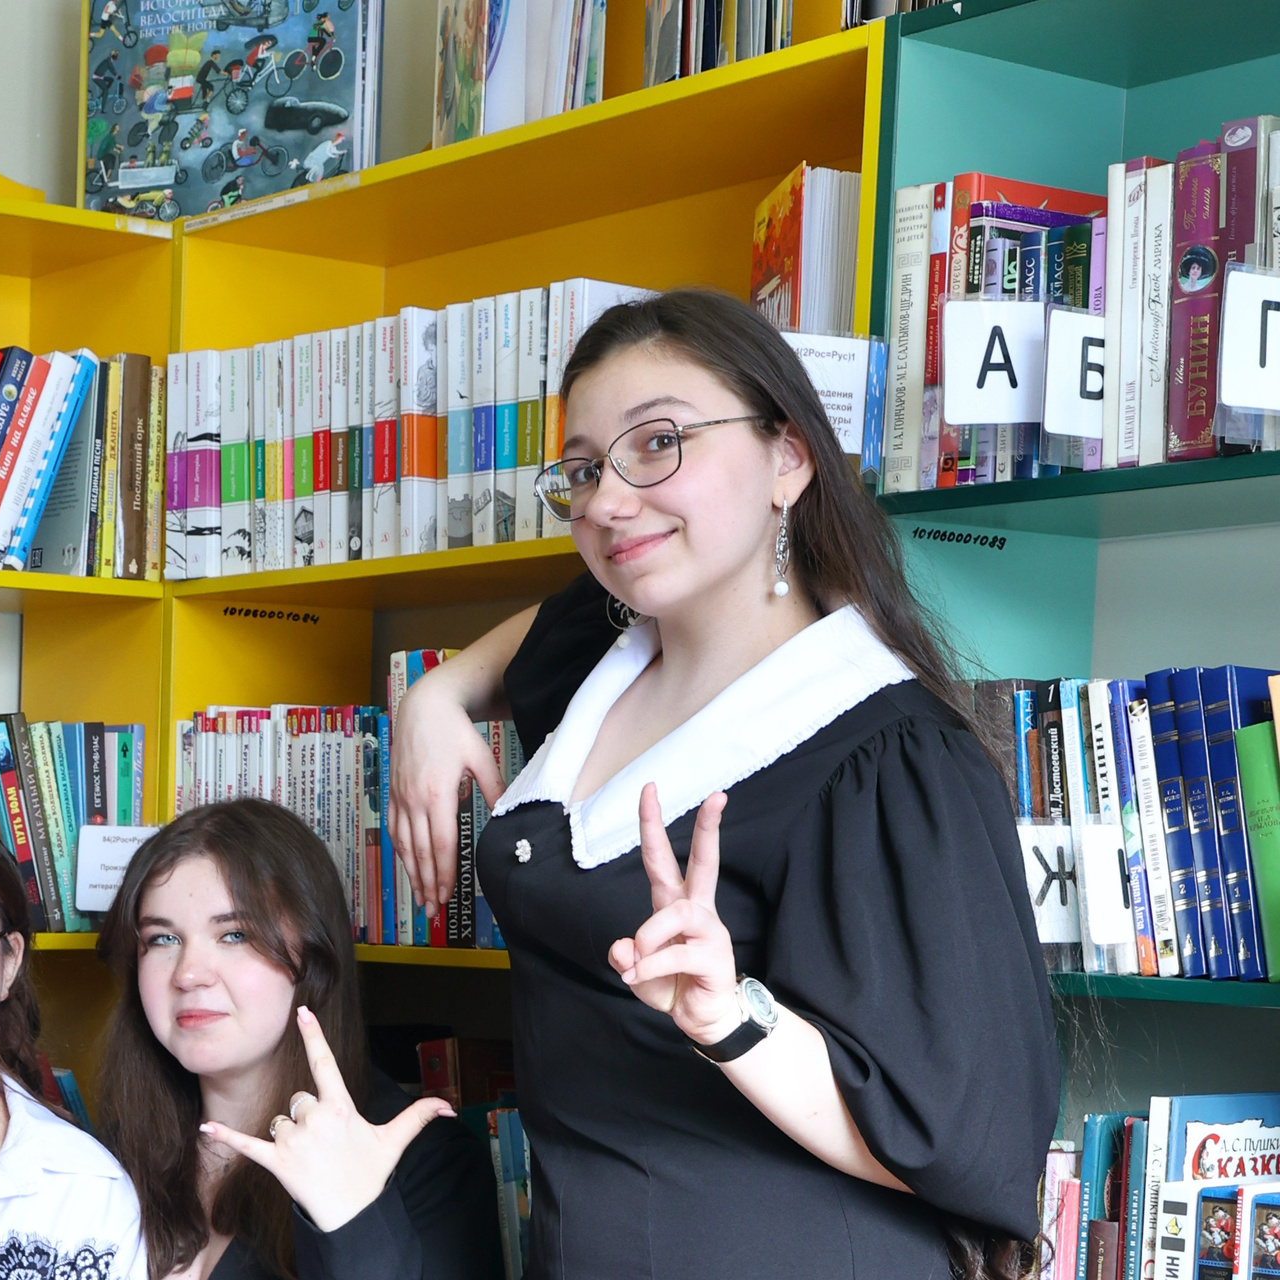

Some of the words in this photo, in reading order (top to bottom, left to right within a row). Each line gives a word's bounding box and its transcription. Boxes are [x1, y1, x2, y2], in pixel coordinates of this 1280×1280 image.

[139, 5, 227, 27] ВЕЛОСИПЕДА
[139, 26, 184, 39] БЫСТРЫЕ
[187, 20, 217, 34] НОГИ
[1152, 223, 1163, 269] ЛИРИКА
[897, 273, 914, 360] САЛТЫКОВ-ЩЕДРИН
[790, 347, 856, 362] 4(2Рос=Рус)1
[976, 325, 1019, 390] А
[1079, 336, 1105, 400] Б
[1174, 356, 1185, 385] Иван
[1187, 313, 1211, 418] БУНИН
[14, 386, 38, 428] пляже
[1123, 380, 1136, 401] БЛОК
[893, 386, 907, 431] ГОНЧАРОВ
[10, 431, 24, 449] на
[109, 409, 118, 460] ДЖАНЕТТА
[135, 417, 145, 440] орк
[1122, 404, 1136, 450] АЛЕКСАНДР
[93, 438, 102, 466] ПЕСНЯ
[91, 467, 101, 513] ЛЕБЕДИНАЯ
[133, 442, 144, 512] Последний
[911, 526, 1007, 551] 101060001089
[223, 606, 319, 625] 101060001084
[20, 739, 31, 769] ЛУК
[92, 734, 101, 772] ТРИВИЗАС
[1047, 726, 1064, 804] Достоевский
[6, 785, 21, 814] ВОЛН
[26, 772, 46, 840] МЕДНЫЙ
[93, 775, 101, 808] ЕВГЕНИОС
[13, 816, 27, 845] ПУТЬ
[45, 867, 56, 901] ЭЛИЗАБЕТ
[461, 811, 473, 939] ХРЕСТОМАТИЯ
[1130, 864, 1145, 904] Бедная
[1179, 883, 1187, 895] 2
[1204, 884, 1211, 895] 3
[1234, 887, 1241, 898] 1
[1133, 904, 1145, 930] Лиза
[1231, 1138, 1242, 1153] С.
[1081, 1181, 1091, 1228] ЛЮДМИЛА
[1130, 1188, 1140, 1237] ЛЮДМИЛА
[1078, 1241, 1087, 1277] РУСЛАН
